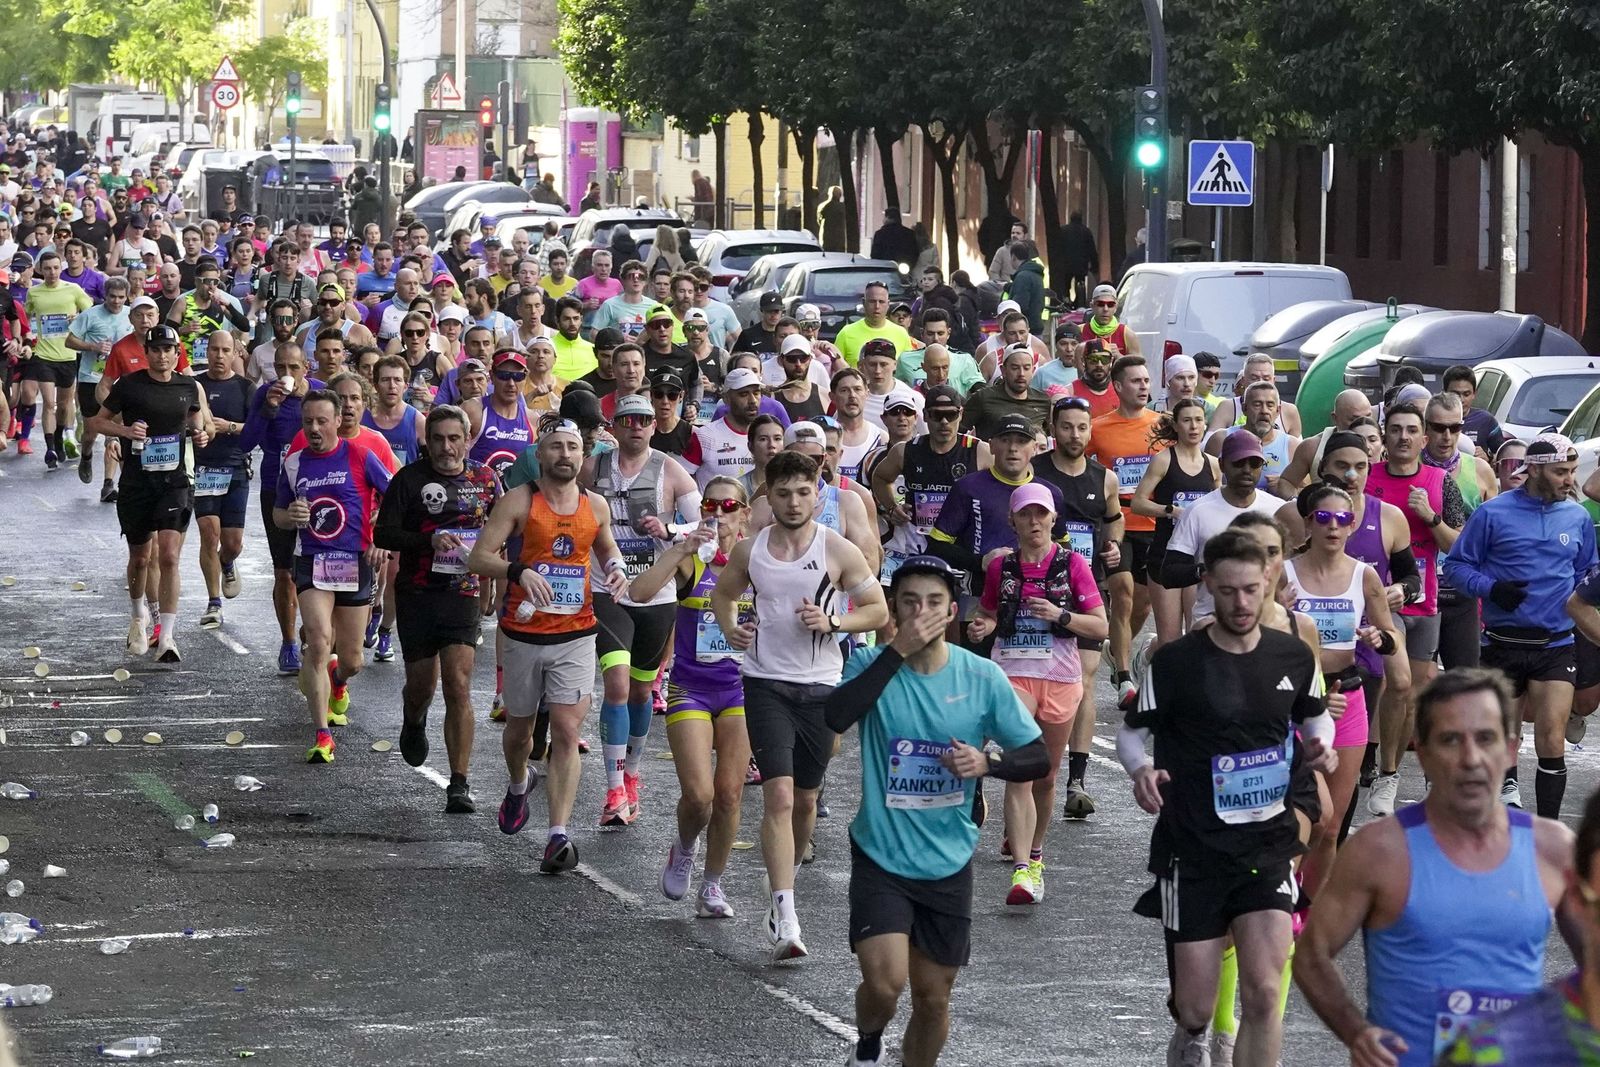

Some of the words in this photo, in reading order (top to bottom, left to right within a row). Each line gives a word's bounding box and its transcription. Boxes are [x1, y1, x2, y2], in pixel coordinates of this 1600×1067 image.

[218, 91, 235, 101] 30
[485, 426, 528, 442] Quintana
[154, 436, 176, 444] ZURICH
[146, 453, 176, 464] IGNACIO
[718, 458, 737, 466] NUNCA
[1127, 456, 1151, 464] ZURICH
[327, 470, 348, 478] Taller
[297, 475, 346, 491] Quintana
[908, 482, 923, 491] LOS
[620, 540, 648, 549] ZURICH
[434, 555, 454, 565] JUAN
[552, 566, 581, 576] ZURICH
[551, 581, 569, 590] 6173
[566, 593, 583, 604] G.S.
[1314, 601, 1349, 610] ZURICH
[1316, 618, 1335, 627] 7196
[1004, 635, 1048, 646] MELANIE
[1239, 750, 1279, 767] ZURICH
[917, 764, 942, 776] 7924
[888, 776, 945, 793] XANKLY
[1242, 775, 1265, 788] 8731
[1218, 784, 1287, 809] MARTINEZ
